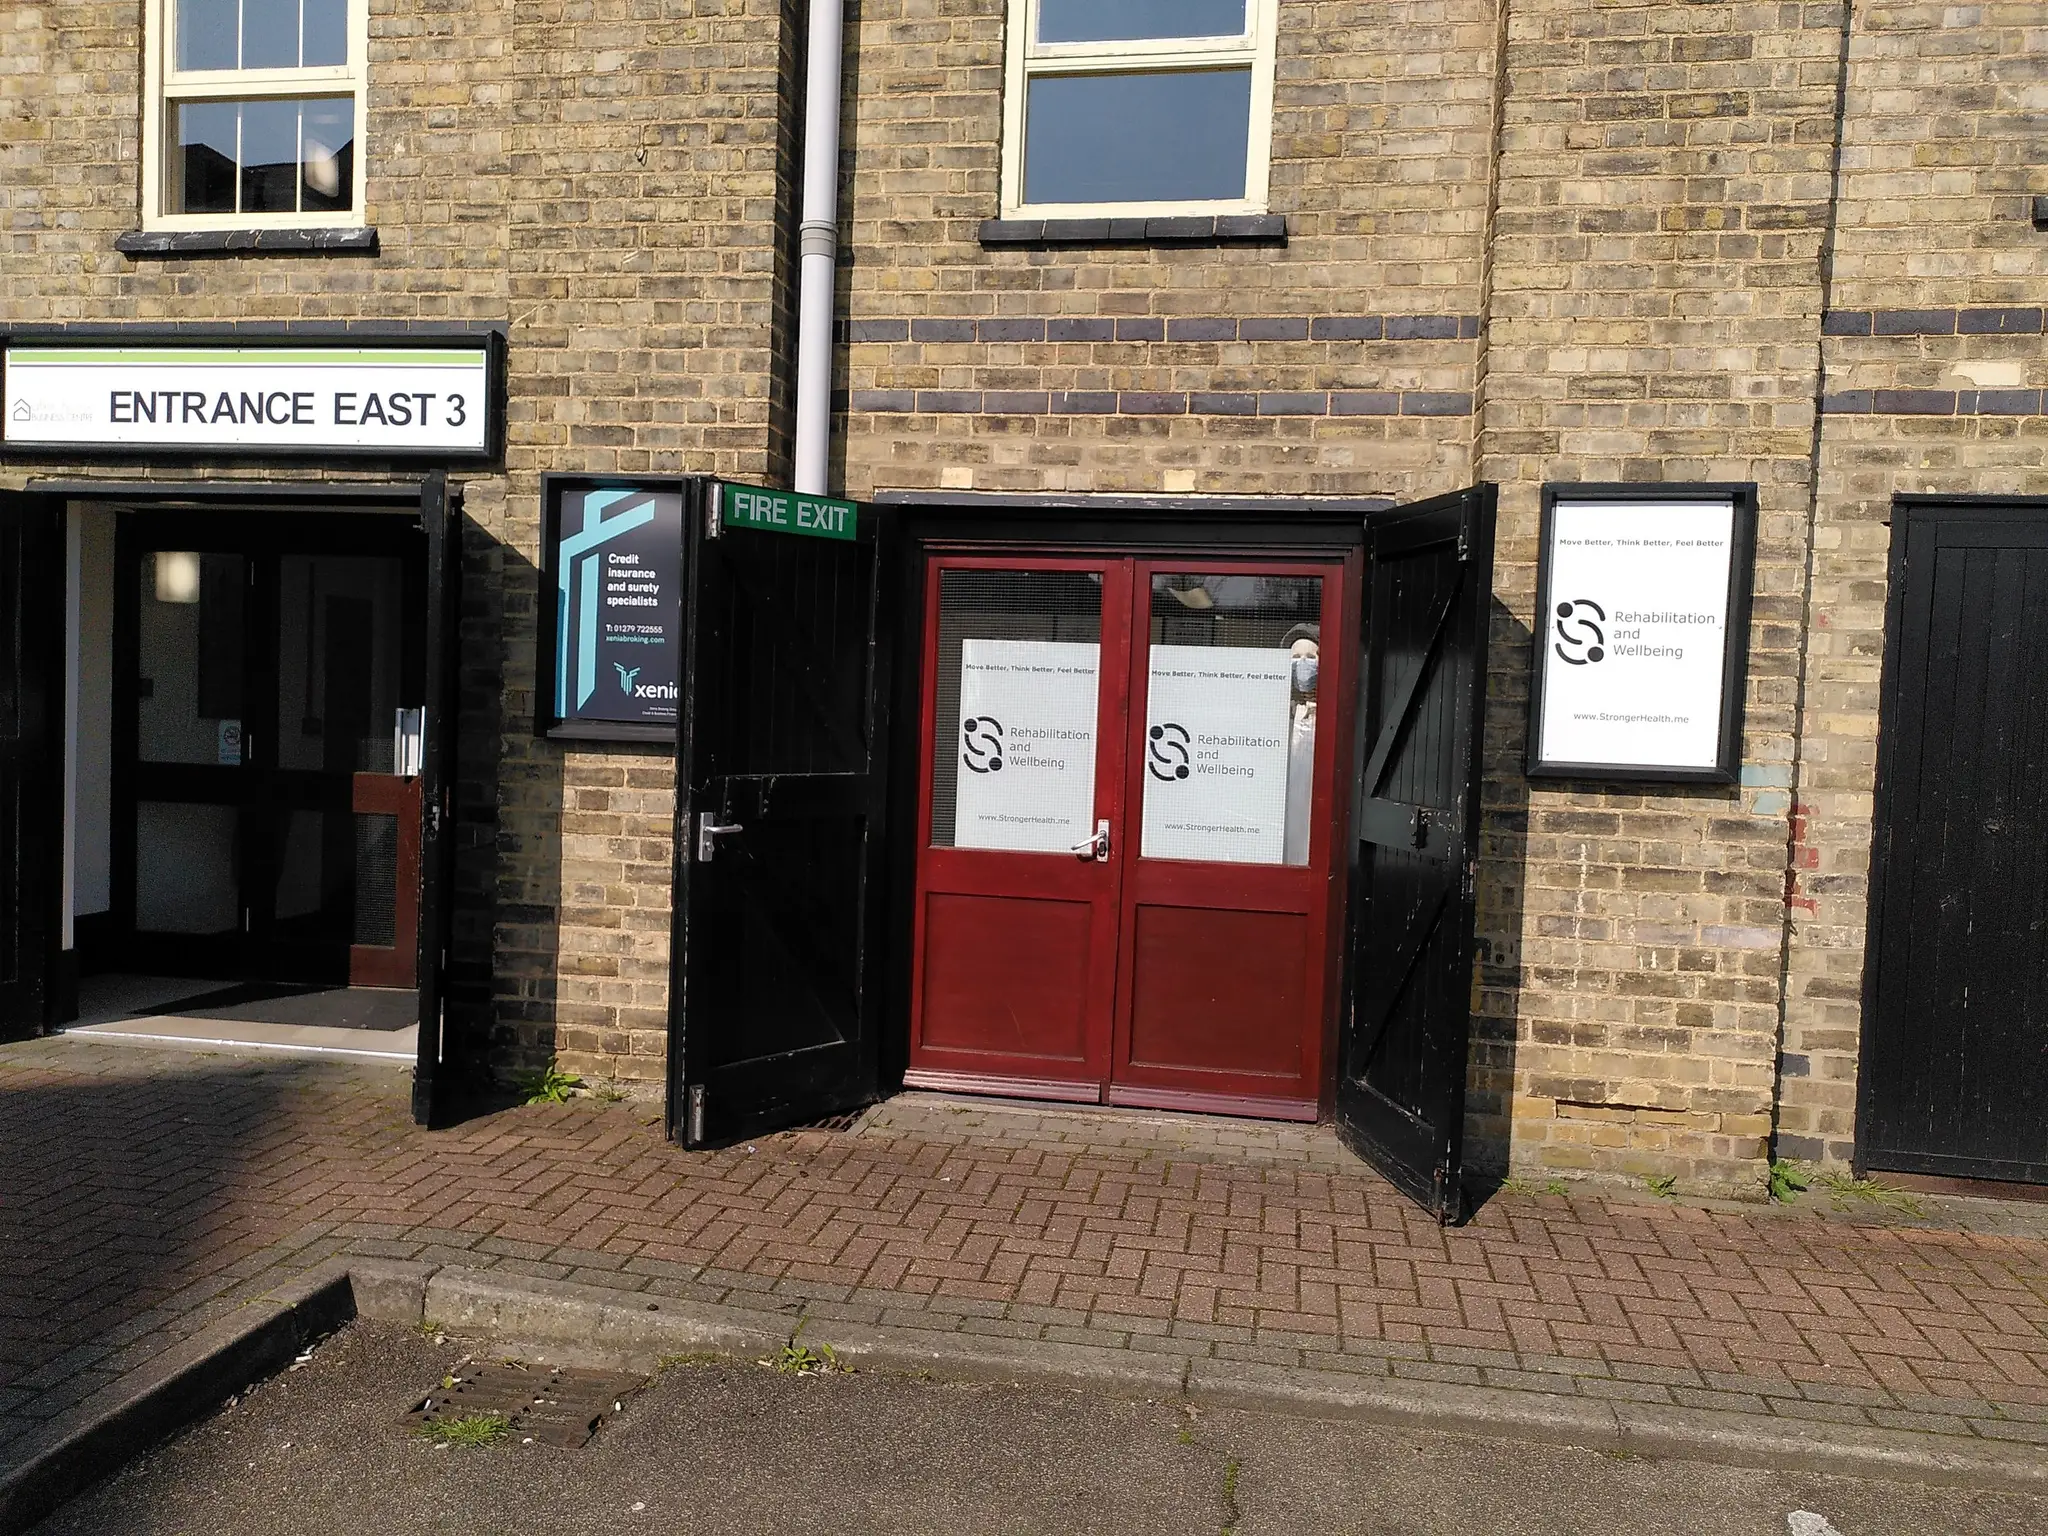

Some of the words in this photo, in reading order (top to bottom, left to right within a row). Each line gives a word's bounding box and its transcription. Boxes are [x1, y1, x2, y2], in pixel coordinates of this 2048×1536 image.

[110, 391, 315, 424] ENTRANCE
[334, 393, 436, 426] EAST
[445, 393, 466, 427] 3
[734, 492, 788, 524] FIRE
[797, 501, 849, 532] EXIT
[608, 553, 640, 564] Credit
[607, 567, 656, 579] insurance
[607, 581, 625, 592] and
[627, 583, 660, 595] surety
[606, 596, 658, 607] specialists
[1614, 611, 1715, 624] Rehabilitation
[613, 625, 636, 633] 01279
[637, 625, 663, 634] 722555
[1613, 628, 1641, 639] and
[605, 635, 665, 644] xeniabroking.com
[1613, 644, 1683, 659] Wellbeing
[1573, 712, 1689, 724] www.StrongerHealth.me
[1009, 728, 1090, 740] Rehabilitation
[1009, 742, 1031, 752] and
[1198, 735, 1280, 748] Rehabilitation
[1196, 750, 1219, 760] and
[1009, 755, 1065, 770] Wellbeing
[1196, 764, 1254, 778] Wellbeing
[978, 813, 1070, 825] www.StrongerHealth.me
[1164, 822, 1260, 834] www.StrongerHealth.me
